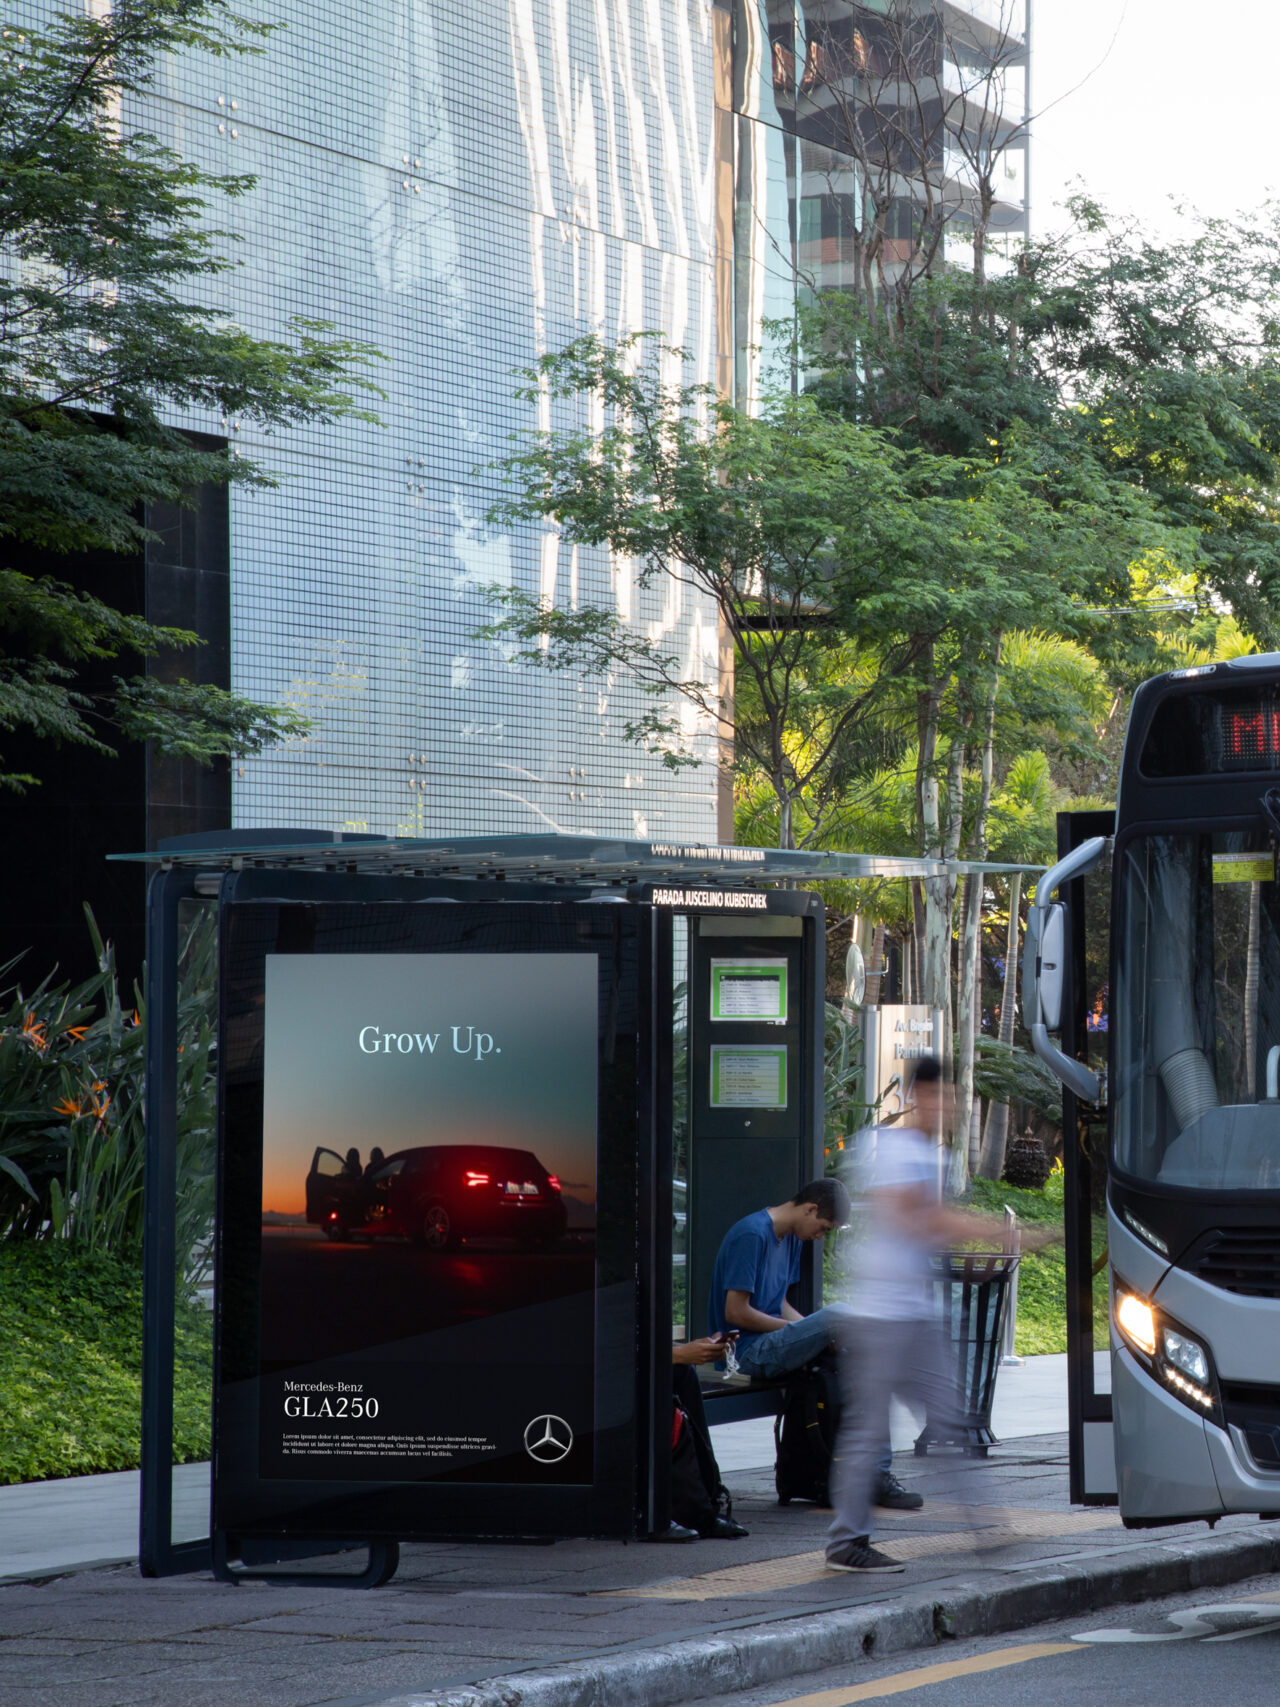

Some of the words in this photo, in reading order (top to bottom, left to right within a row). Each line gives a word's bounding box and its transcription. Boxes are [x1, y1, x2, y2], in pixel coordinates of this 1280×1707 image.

[652, 889, 684, 905] PARADA
[685, 890, 723, 907] JUSCELINO
[724, 892, 767, 909] KUBISTCHEK
[358, 1026, 441, 1054] Grow
[450, 1026, 502, 1061] Up.
[284, 1381, 363, 1392] Mercedes-Benz
[284, 1396, 379, 1418] GLA250
